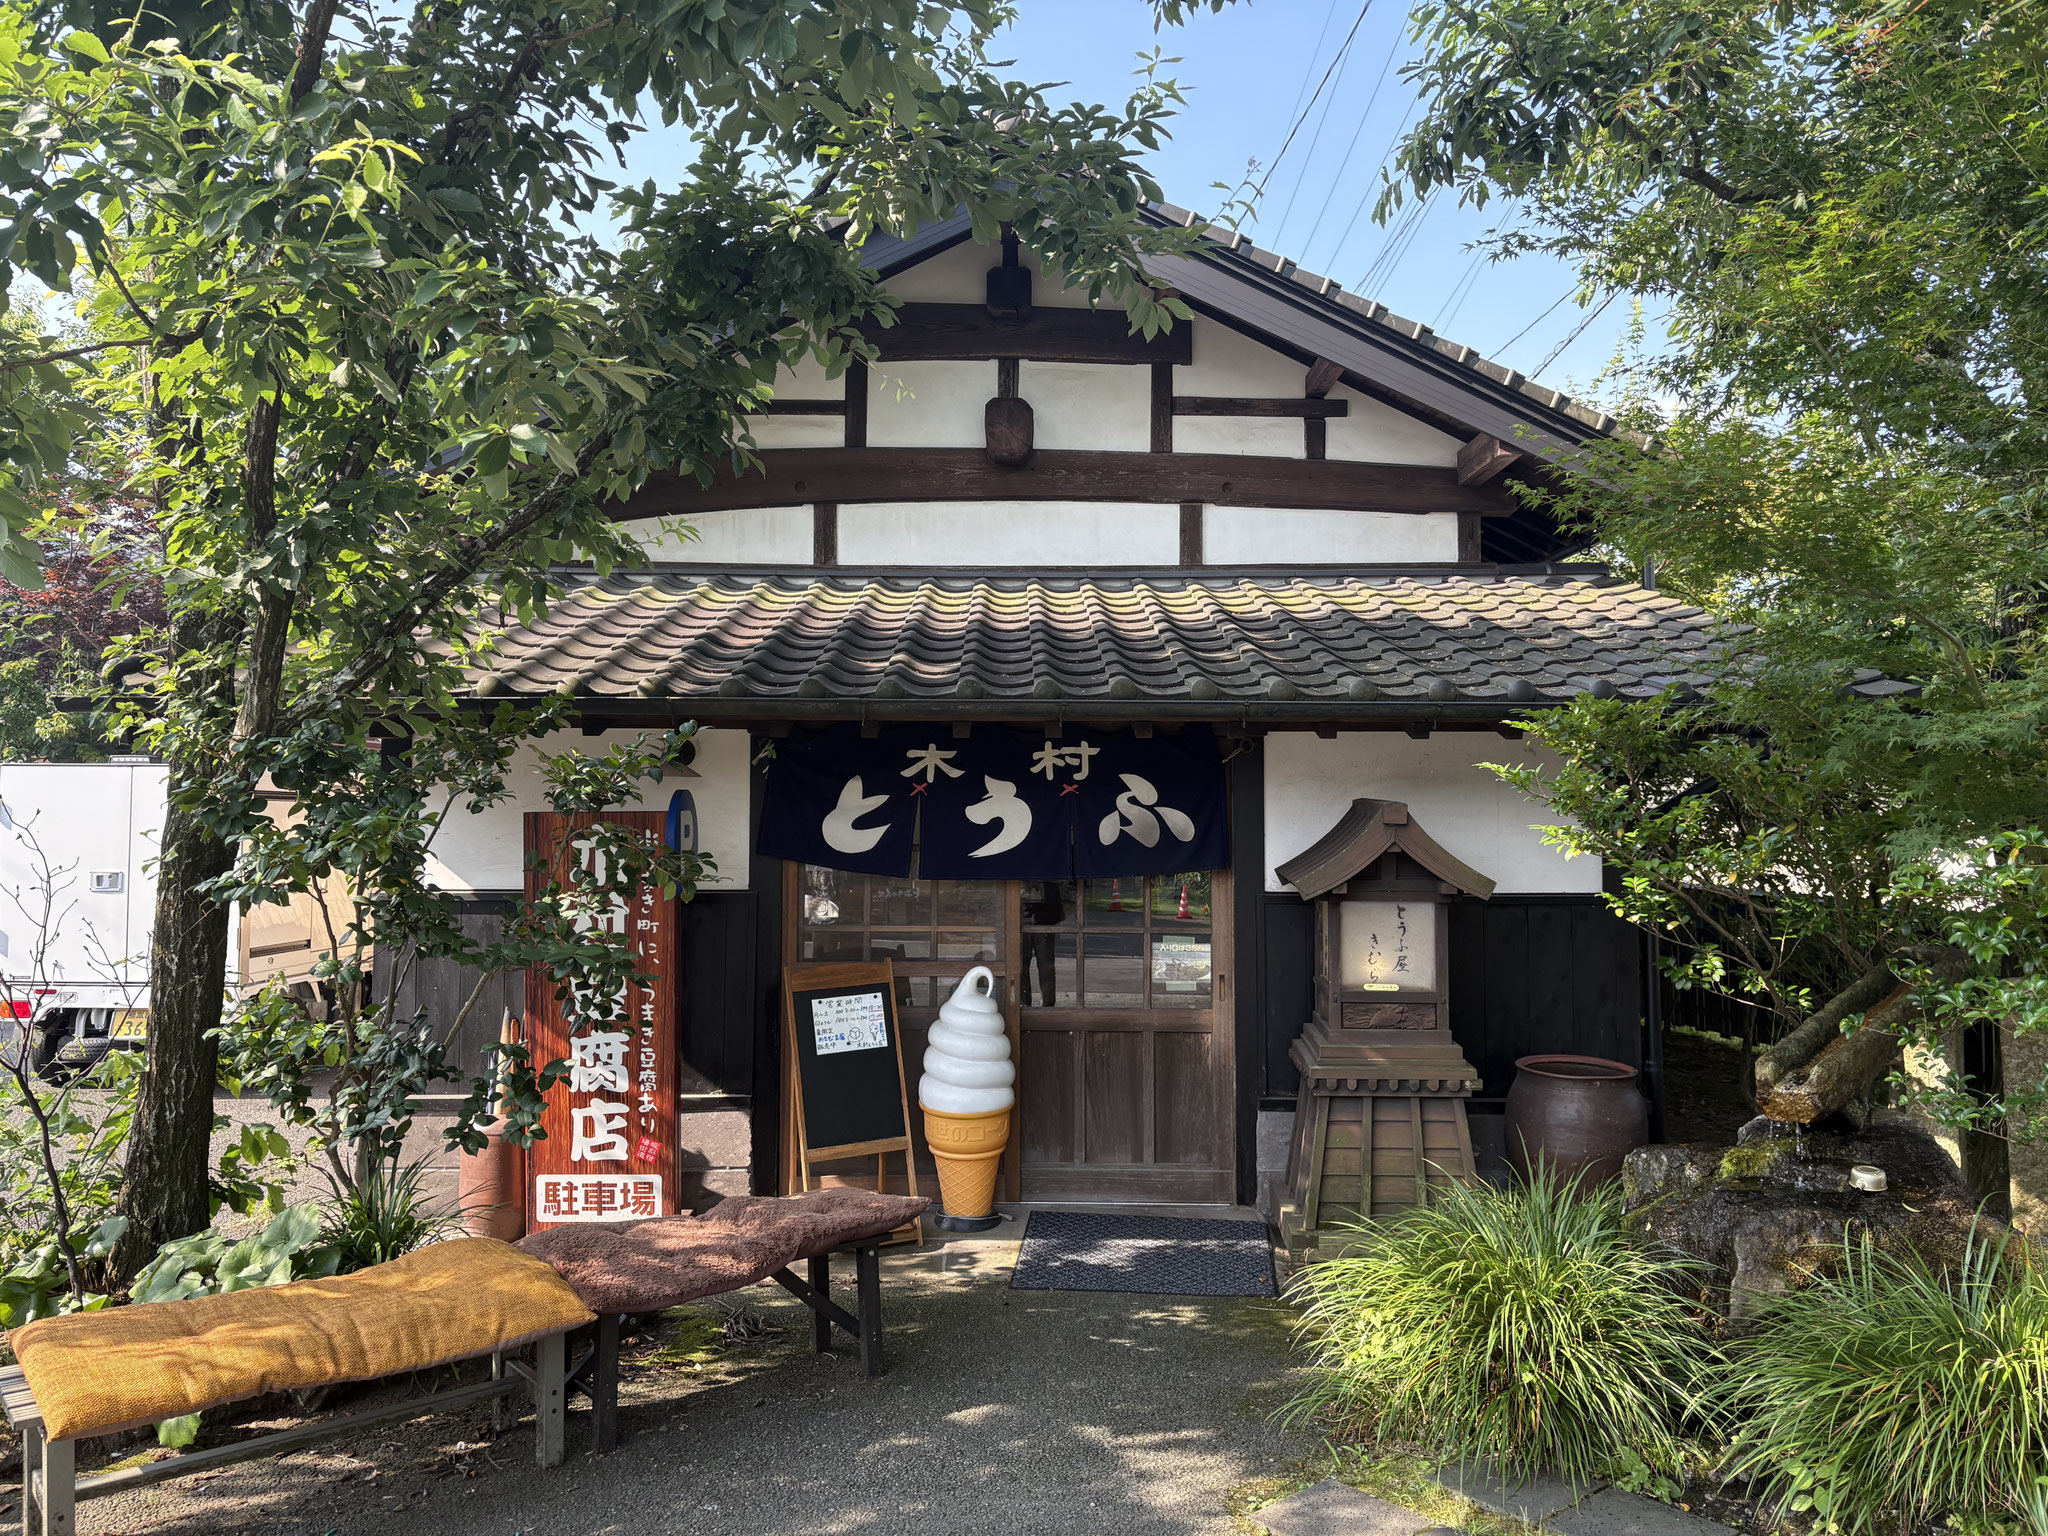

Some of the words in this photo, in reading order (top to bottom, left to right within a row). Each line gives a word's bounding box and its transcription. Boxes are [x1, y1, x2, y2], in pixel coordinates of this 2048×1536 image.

[900, 740, 1101, 783] 木村
[821, 773, 1195, 859] とうふ
[1367, 933, 1382, 983] きむら
[1392, 903, 1410, 973] とうふ屋
[543, 1181, 656, 1216] 駐車場
